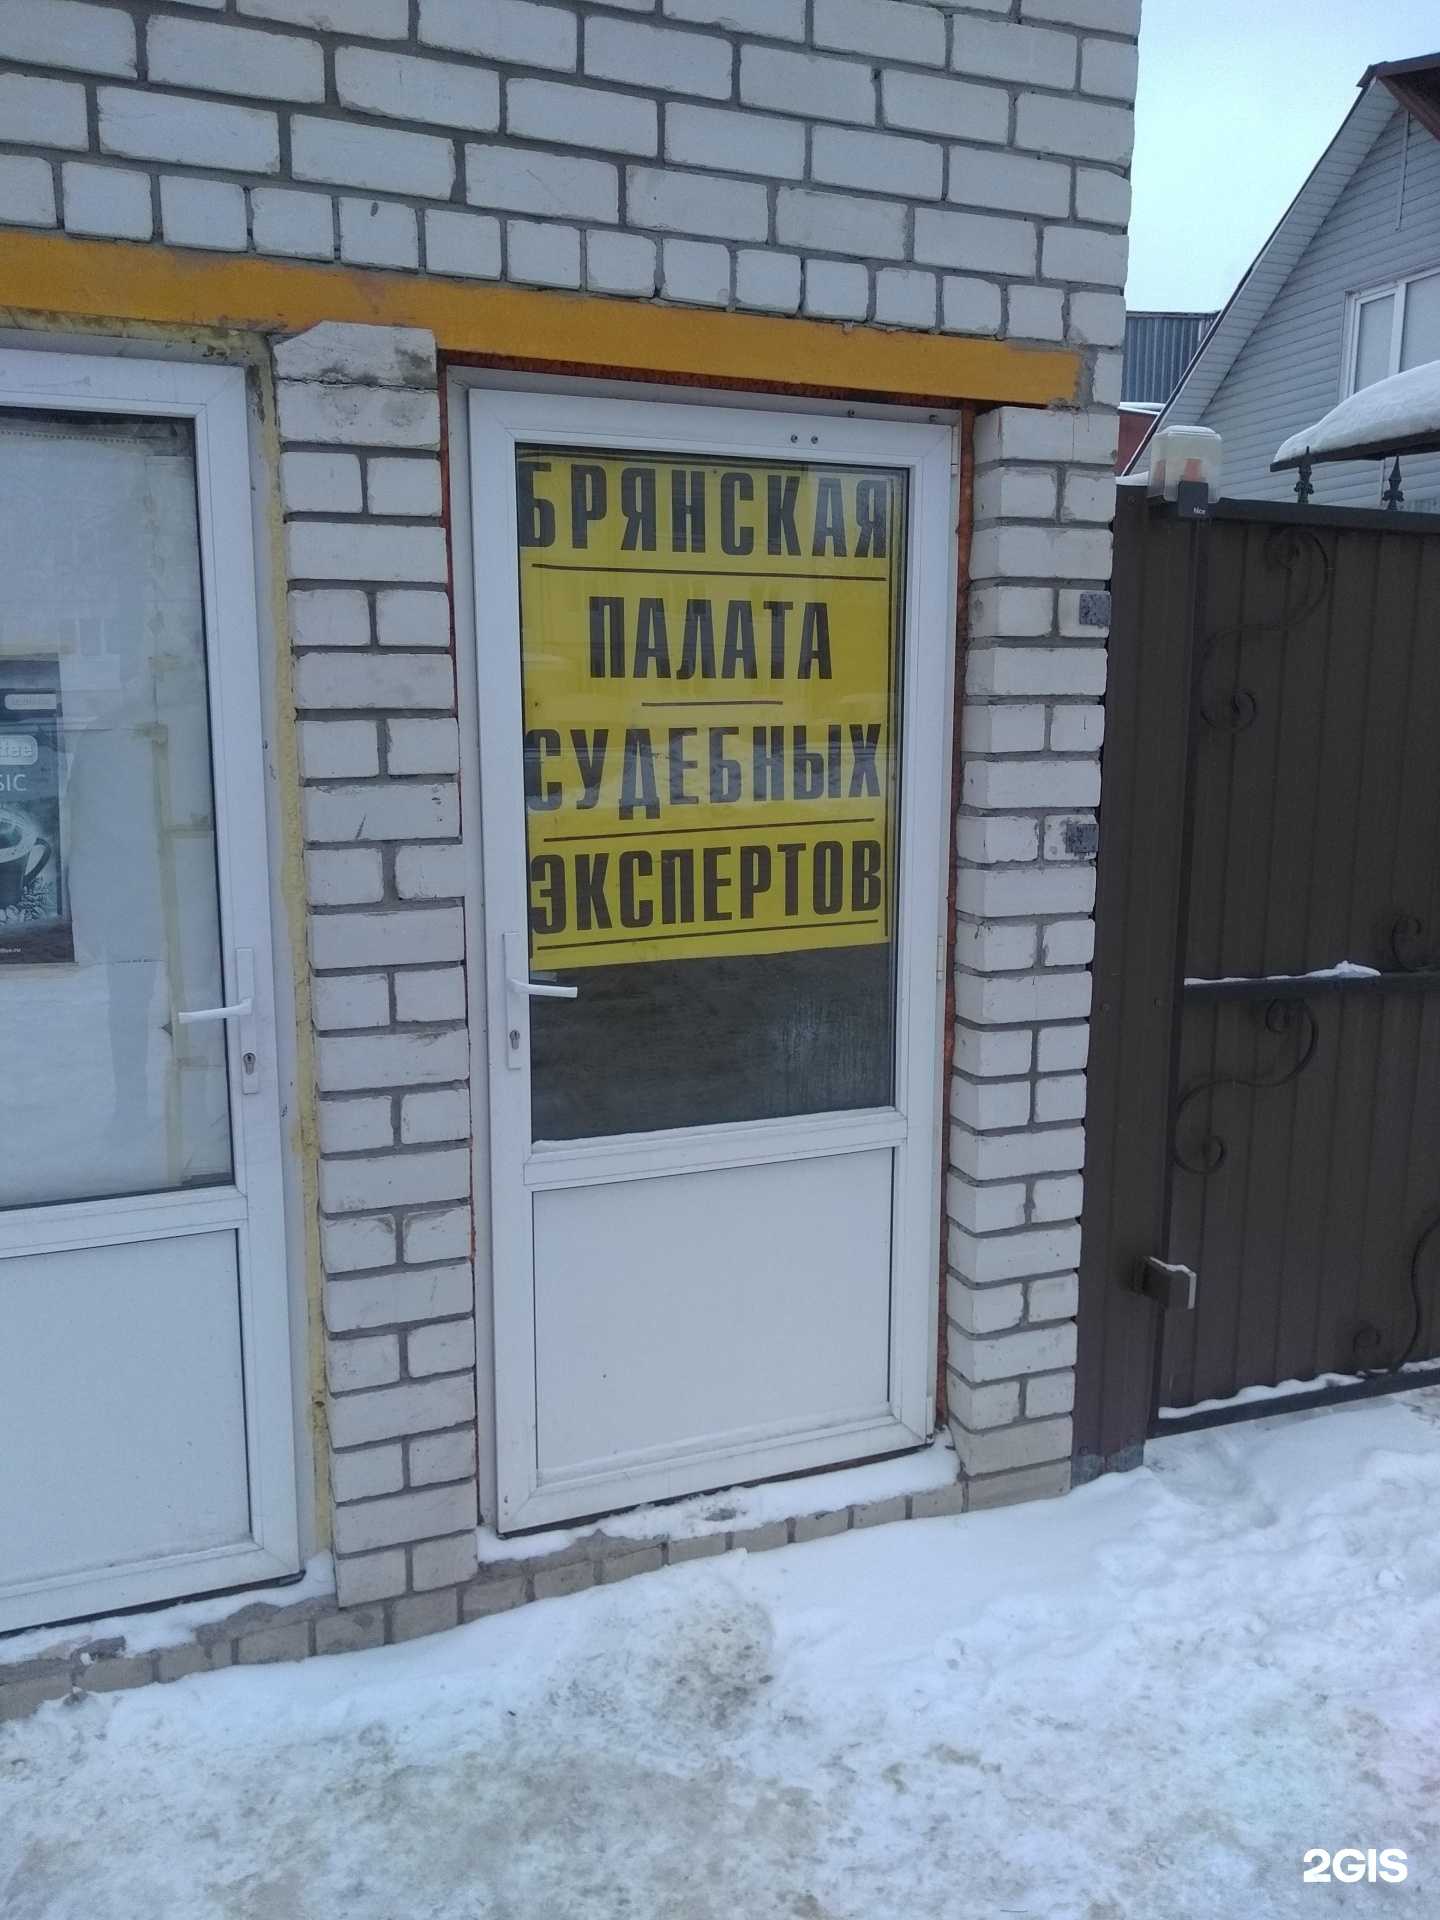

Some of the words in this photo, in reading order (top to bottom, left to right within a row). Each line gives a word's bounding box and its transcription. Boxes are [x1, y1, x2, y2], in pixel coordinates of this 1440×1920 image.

[518, 461, 887, 559] БРЯНСКАЯ
[588, 596, 833, 680] ПАЛАТА
[525, 723, 882, 821] СУДЕБНЫХ
[531, 839, 882, 935] ЭКСПЕРТОВ
